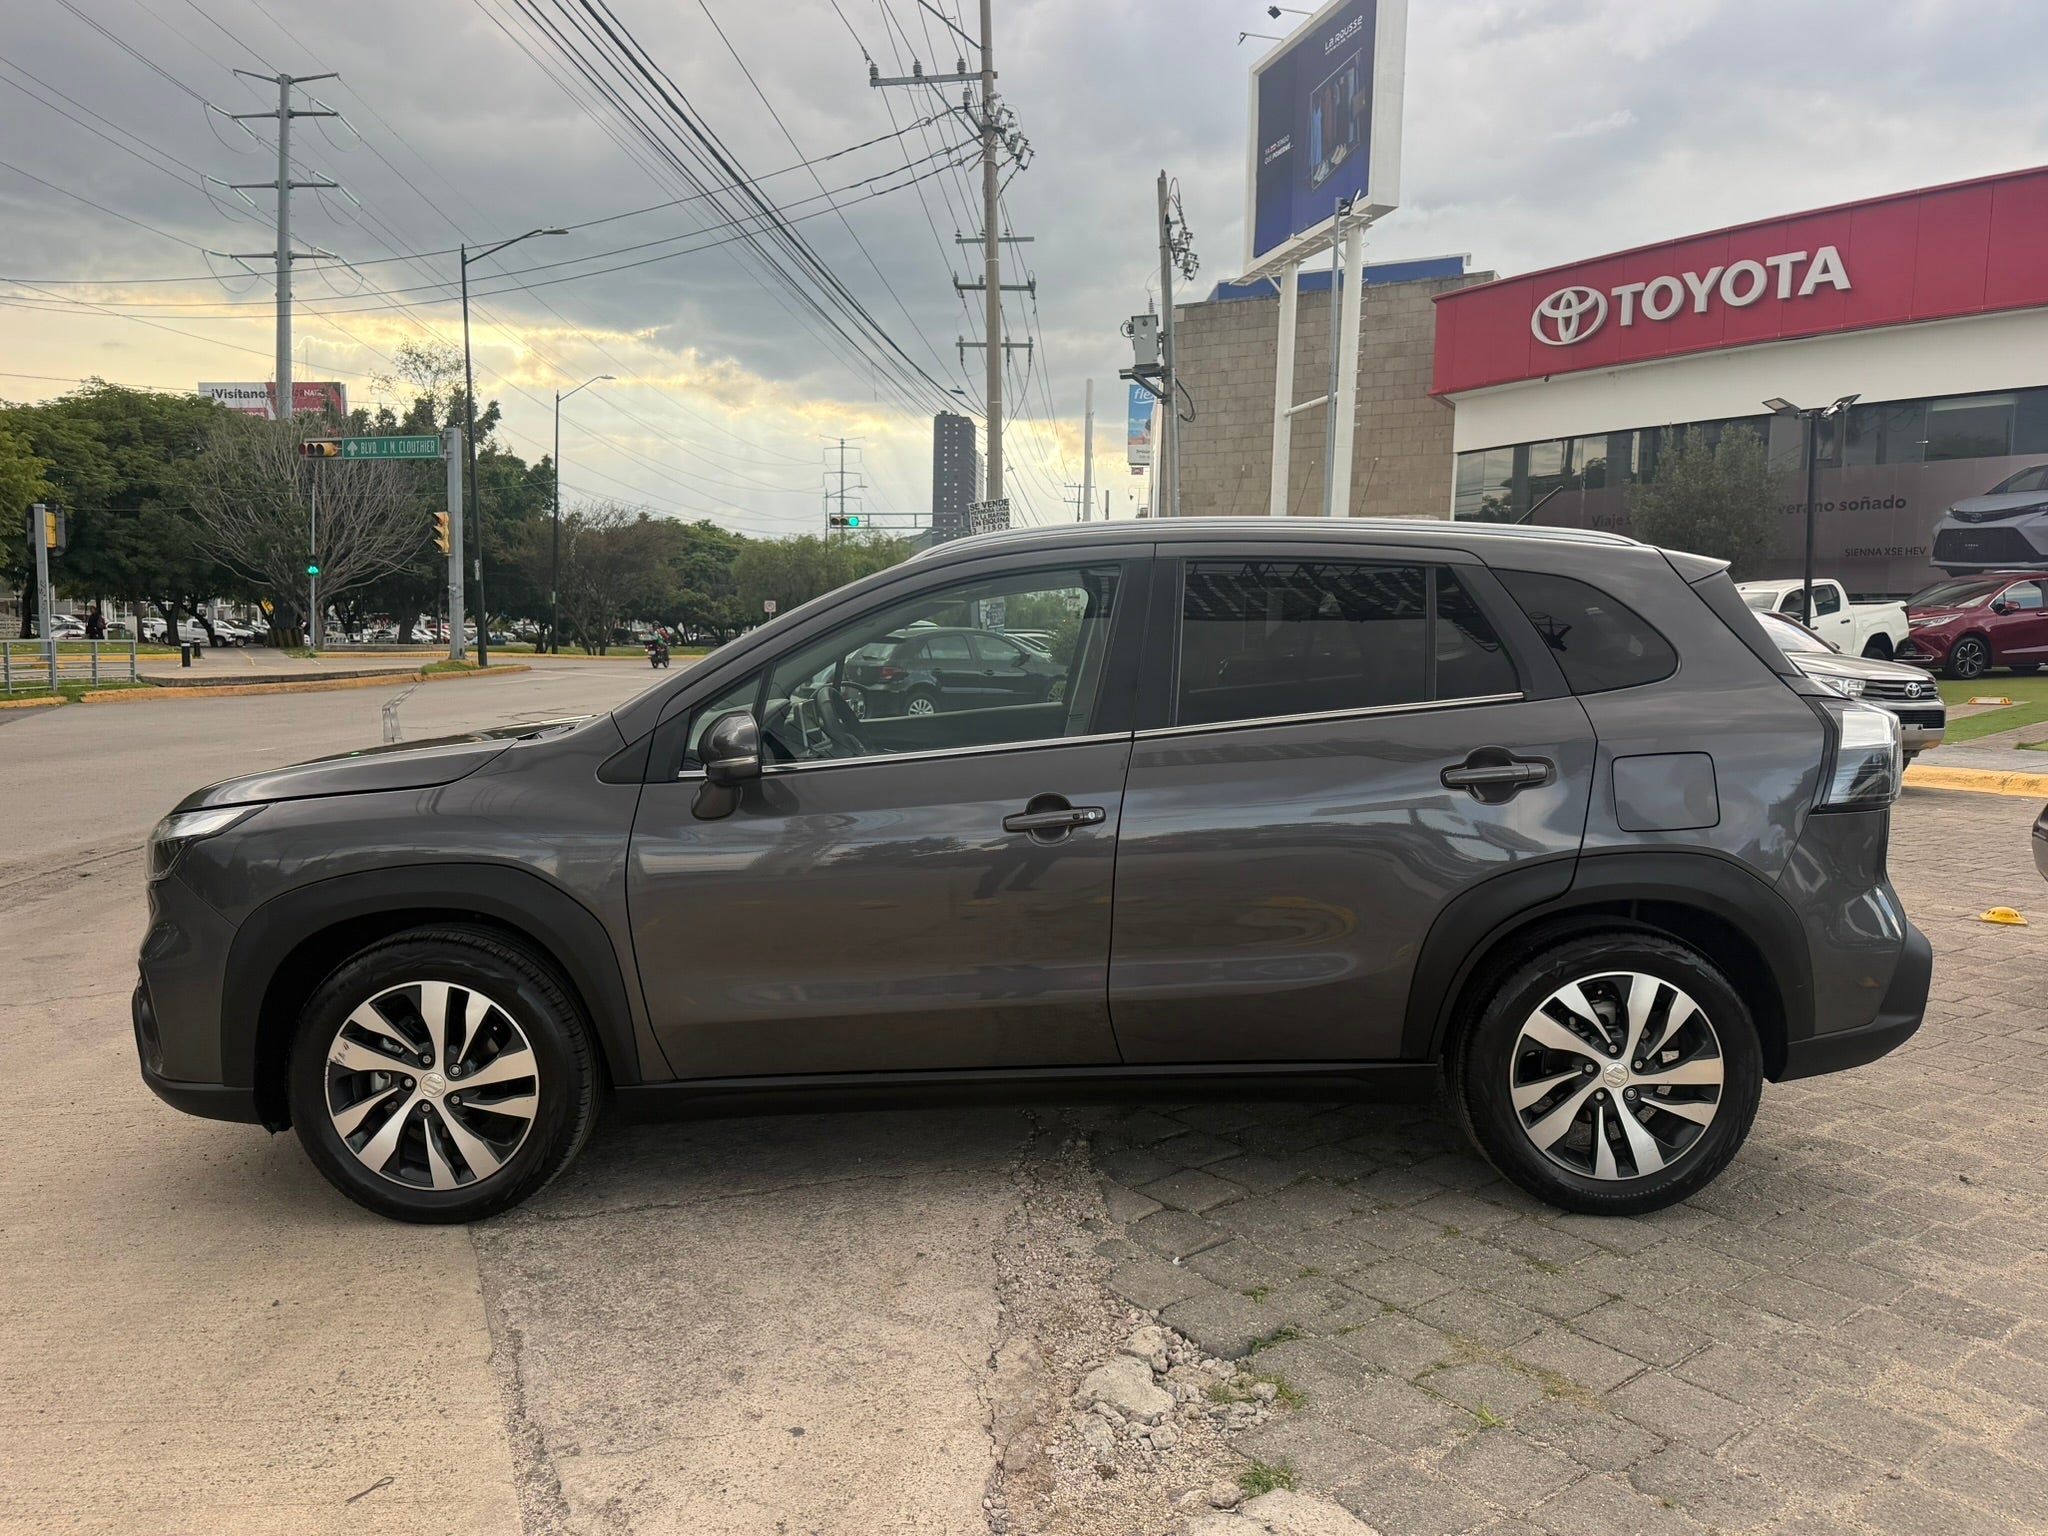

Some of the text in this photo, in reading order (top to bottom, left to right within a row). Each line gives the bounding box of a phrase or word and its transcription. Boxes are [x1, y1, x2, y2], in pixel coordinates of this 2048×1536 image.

[1611, 245, 1852, 327] TOYOTA
[398, 440, 435, 454] CLOUTHIER
[969, 499, 1010, 512] SE VENDE
[1838, 494, 1907, 512] soñado
[971, 520, 982, 528] EN
[1844, 546, 1927, 557] SIENNA XSE HEV
